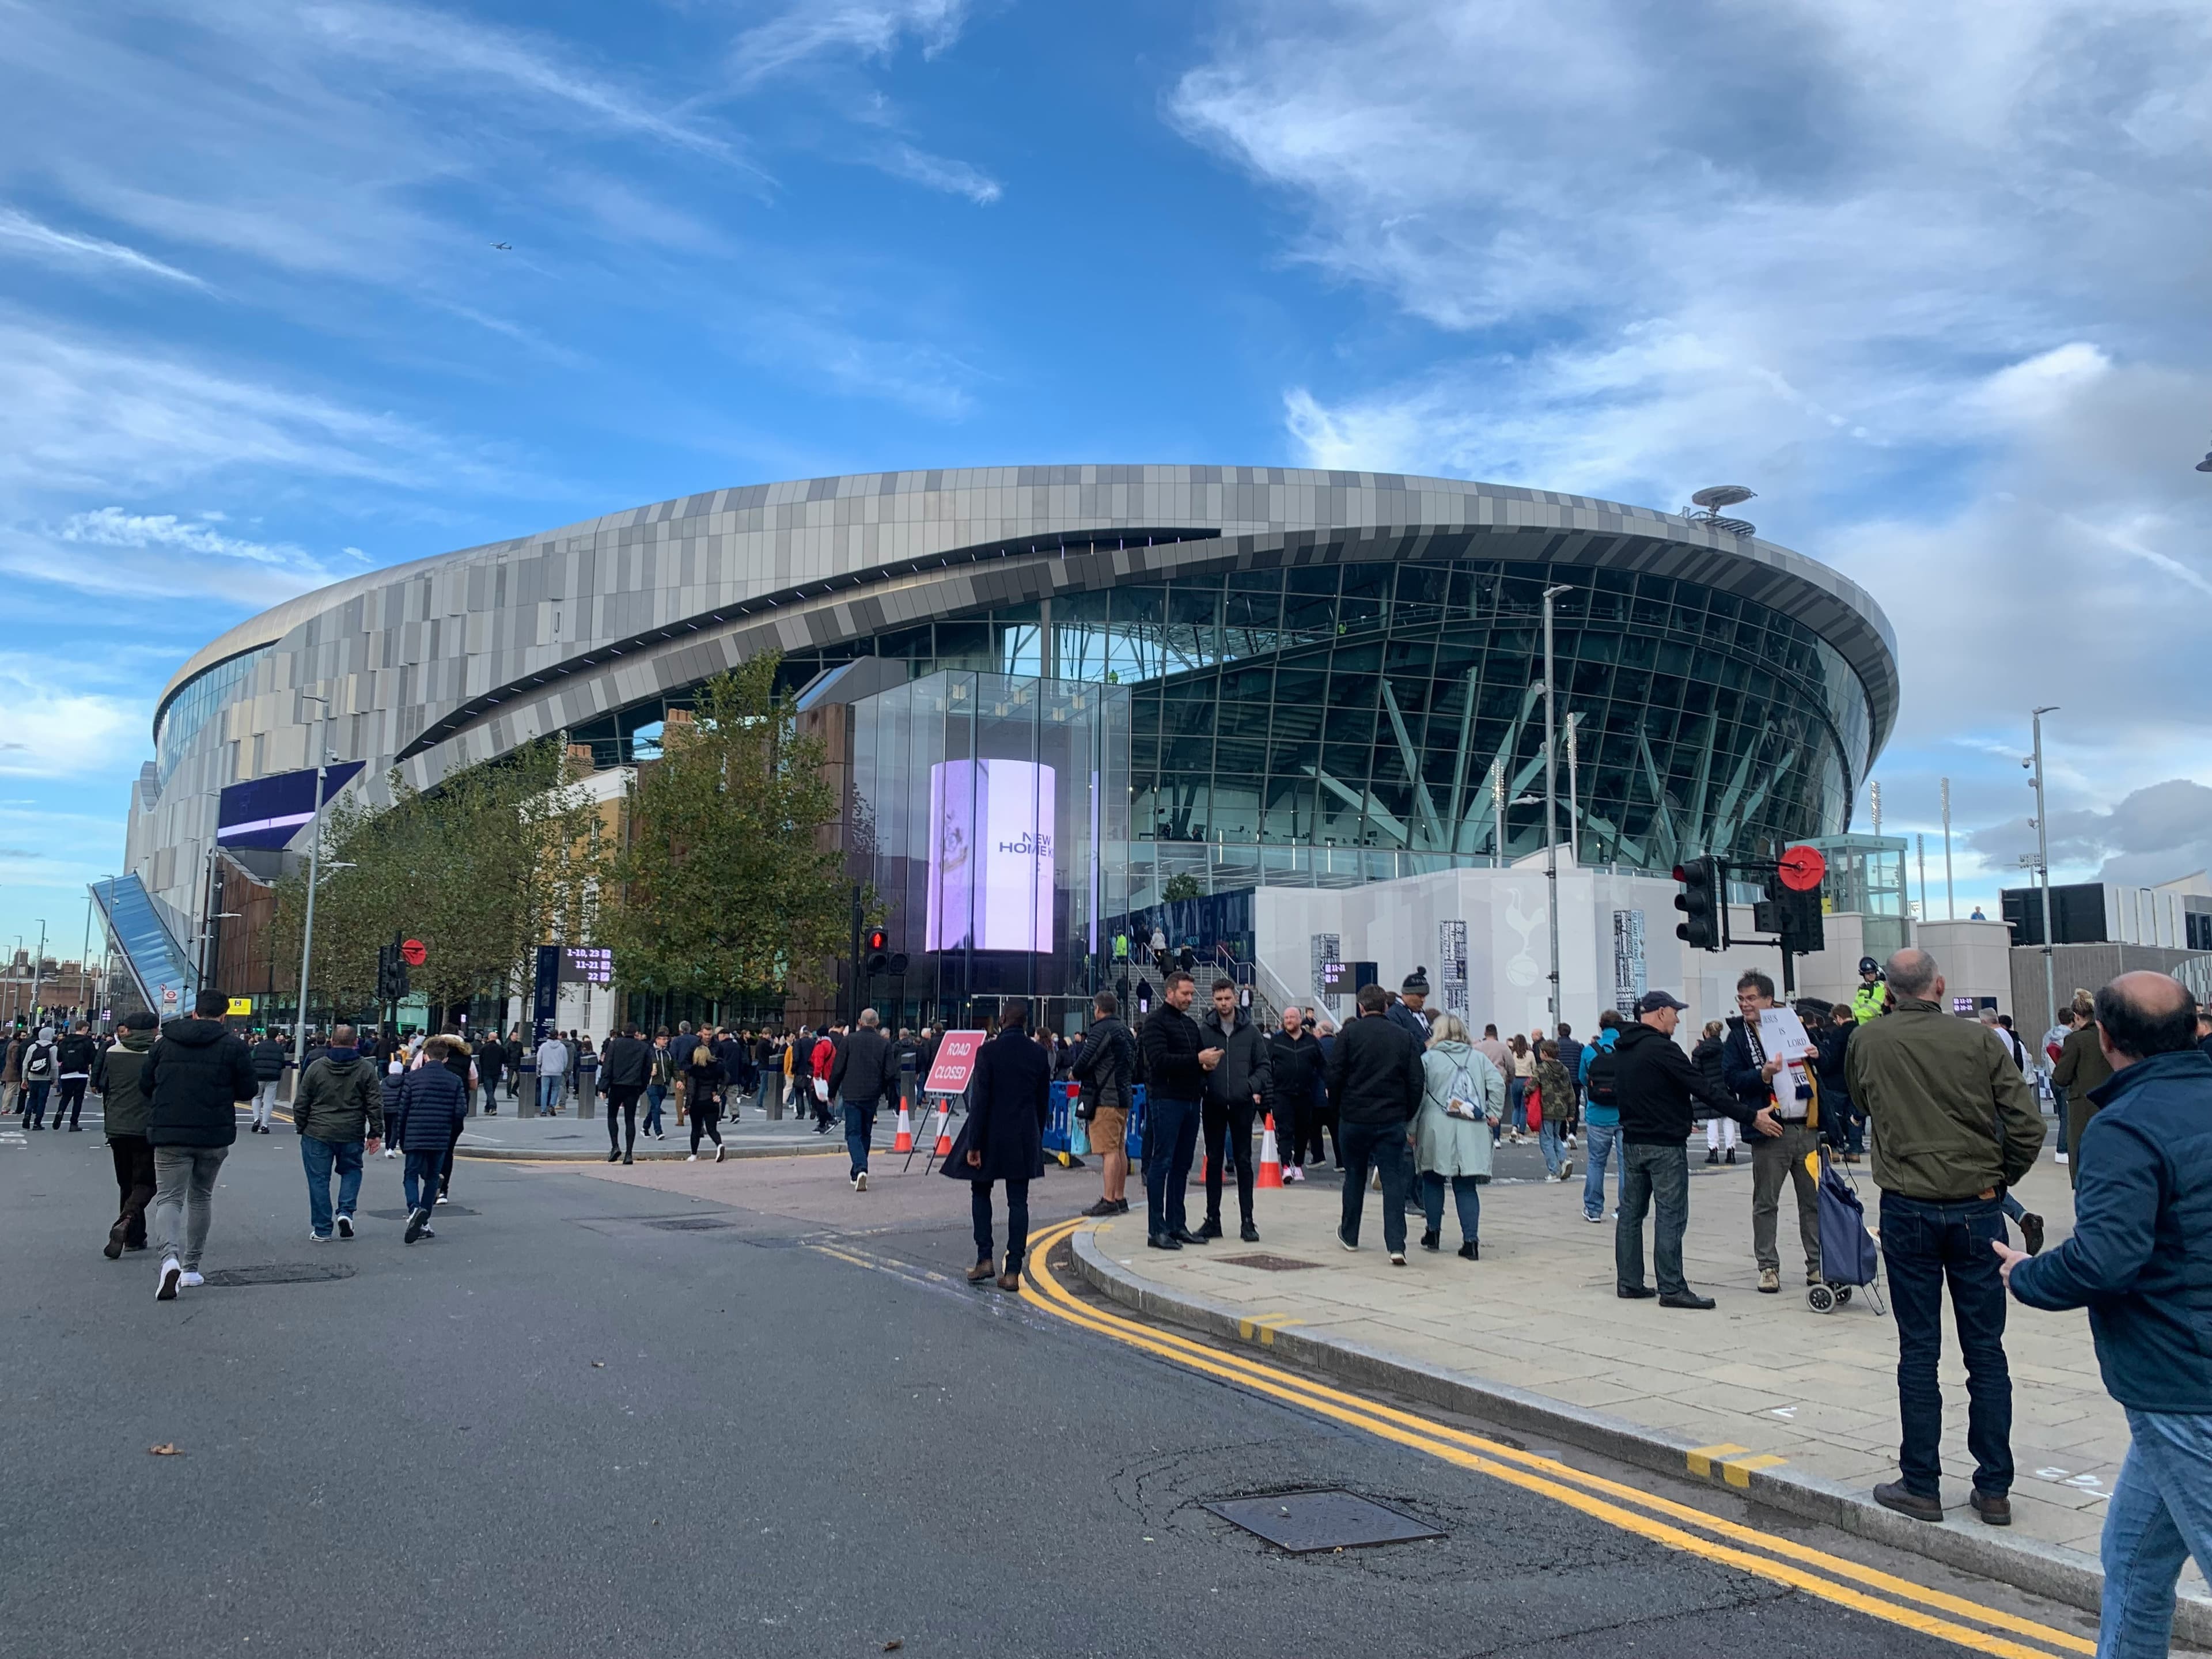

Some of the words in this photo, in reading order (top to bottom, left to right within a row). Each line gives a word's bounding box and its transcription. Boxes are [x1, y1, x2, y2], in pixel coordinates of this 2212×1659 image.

[1022, 832, 1051, 846] NEW
[999, 842, 1047, 856] HOME
[567, 949, 588, 958] 1-10,
[576, 960, 599, 969] 11-21
[1332, 964, 1346, 972] 11-21
[1763, 1014, 1778, 1024] JESUS
[1779, 1027, 1786, 1035] IS
[1787, 1037, 1806, 1048] LORD
[946, 1042, 971, 1056] ROAD
[33, 1058, 47, 1068] NIKE
[934, 1065, 967, 1080] CLOSED
